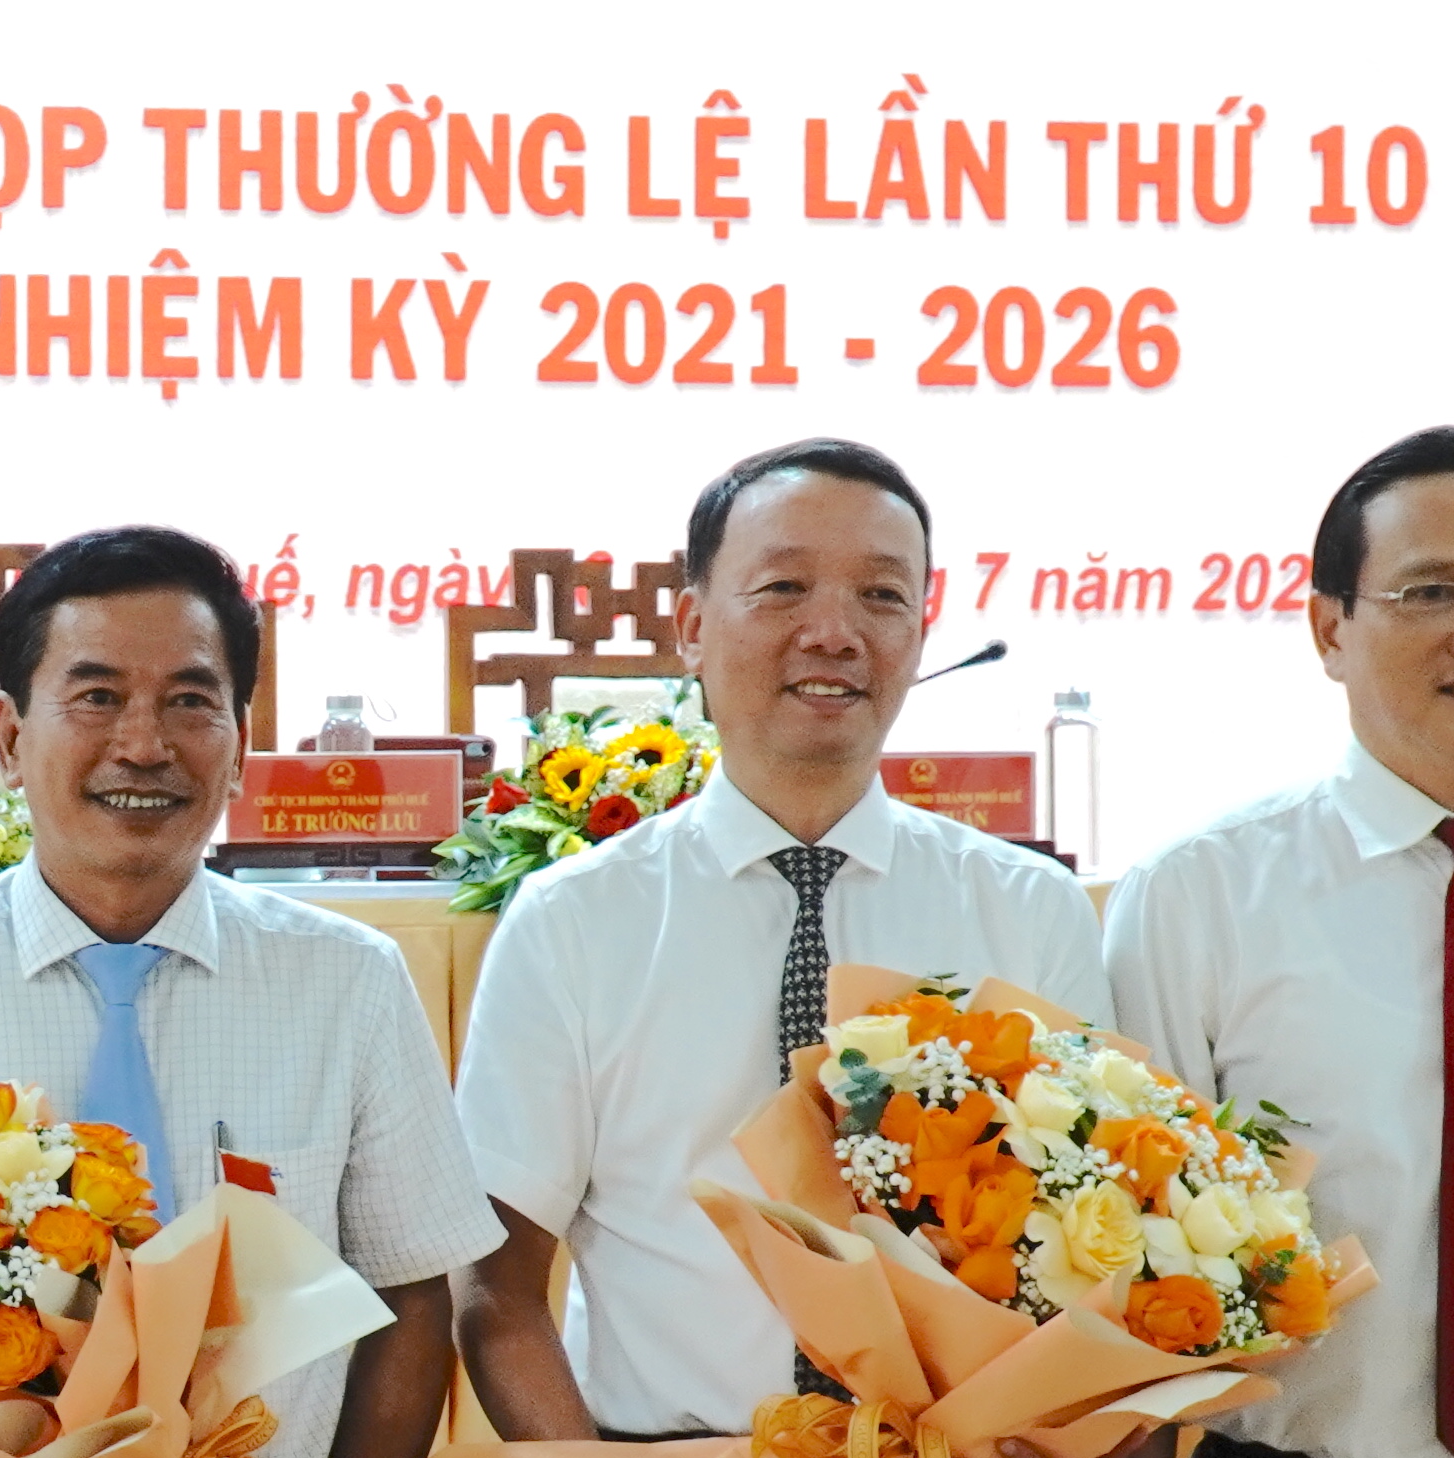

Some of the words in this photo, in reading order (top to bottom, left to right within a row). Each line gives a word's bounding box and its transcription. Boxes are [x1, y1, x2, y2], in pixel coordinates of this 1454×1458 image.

[144, 85, 585, 216] THƯỜNG
[628, 90, 750, 239] LỆ
[805, 74, 1006, 220] LẦN
[1047, 97, 1265, 224] THỨ
[1310, 126, 1427, 226] 10
[351, 253, 489, 381] KỲ
[538, 282, 798, 384] 2021
[846, 339, 874, 359] -
[918, 286, 1180, 388] 2026
[242, 534, 314, 618] uế,
[977, 553, 1009, 609] 7
[1032, 552, 1171, 611] năm
[1194, 554, 1313, 611] 202
[262, 809, 288, 832] LÊ
[292, 809, 377, 833] TRƯỜNG
[380, 810, 423, 832] LƯU
